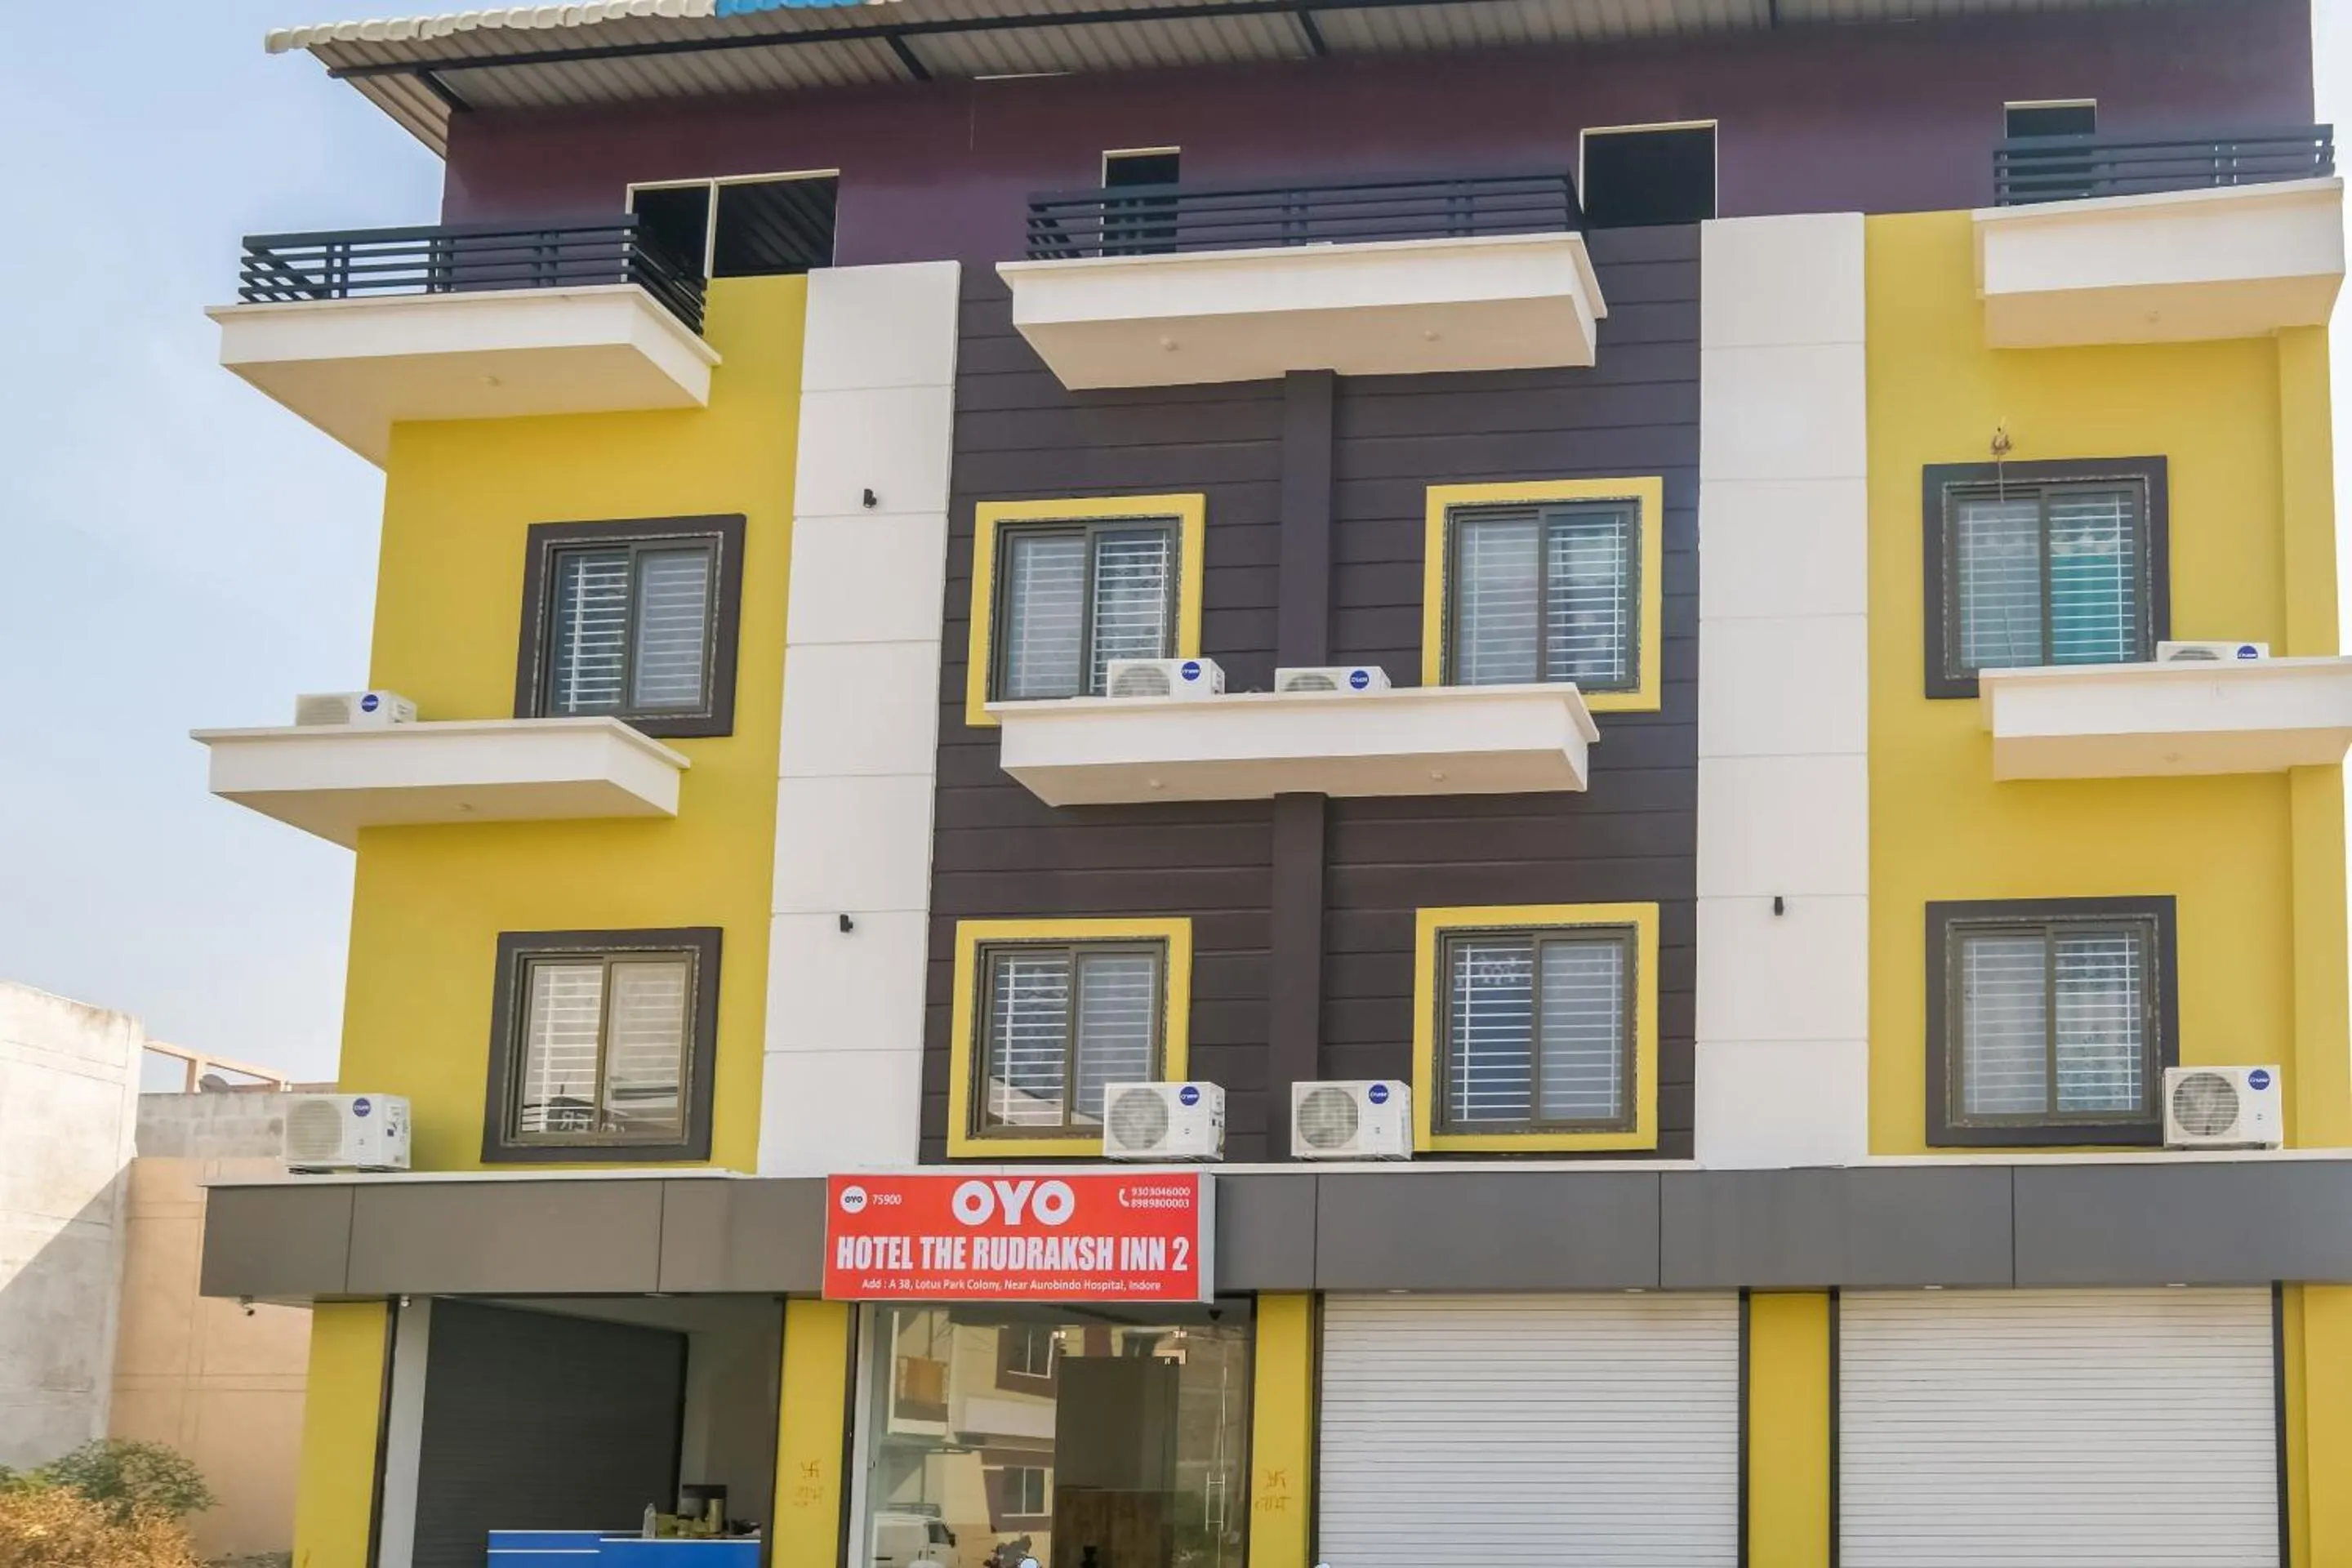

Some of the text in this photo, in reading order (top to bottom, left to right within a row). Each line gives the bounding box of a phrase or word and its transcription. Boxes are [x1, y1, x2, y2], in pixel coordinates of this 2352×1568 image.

[951, 1181, 1076, 1226] OYO
[836, 1236, 1190, 1271] HOTEL THE RUDRAKSH INN 2
[862, 1278, 882, 1290] Add
[888, 1278, 897, 1290] A
[915, 1279, 941, 1290] Lotus
[942, 1278, 965, 1290] Park
[1004, 1279, 1027, 1290] Near
[1029, 1279, 1081, 1290] Aurobindo
[1084, 1279, 1127, 1293] Hospital,
[1129, 1280, 1161, 1291] Indore
